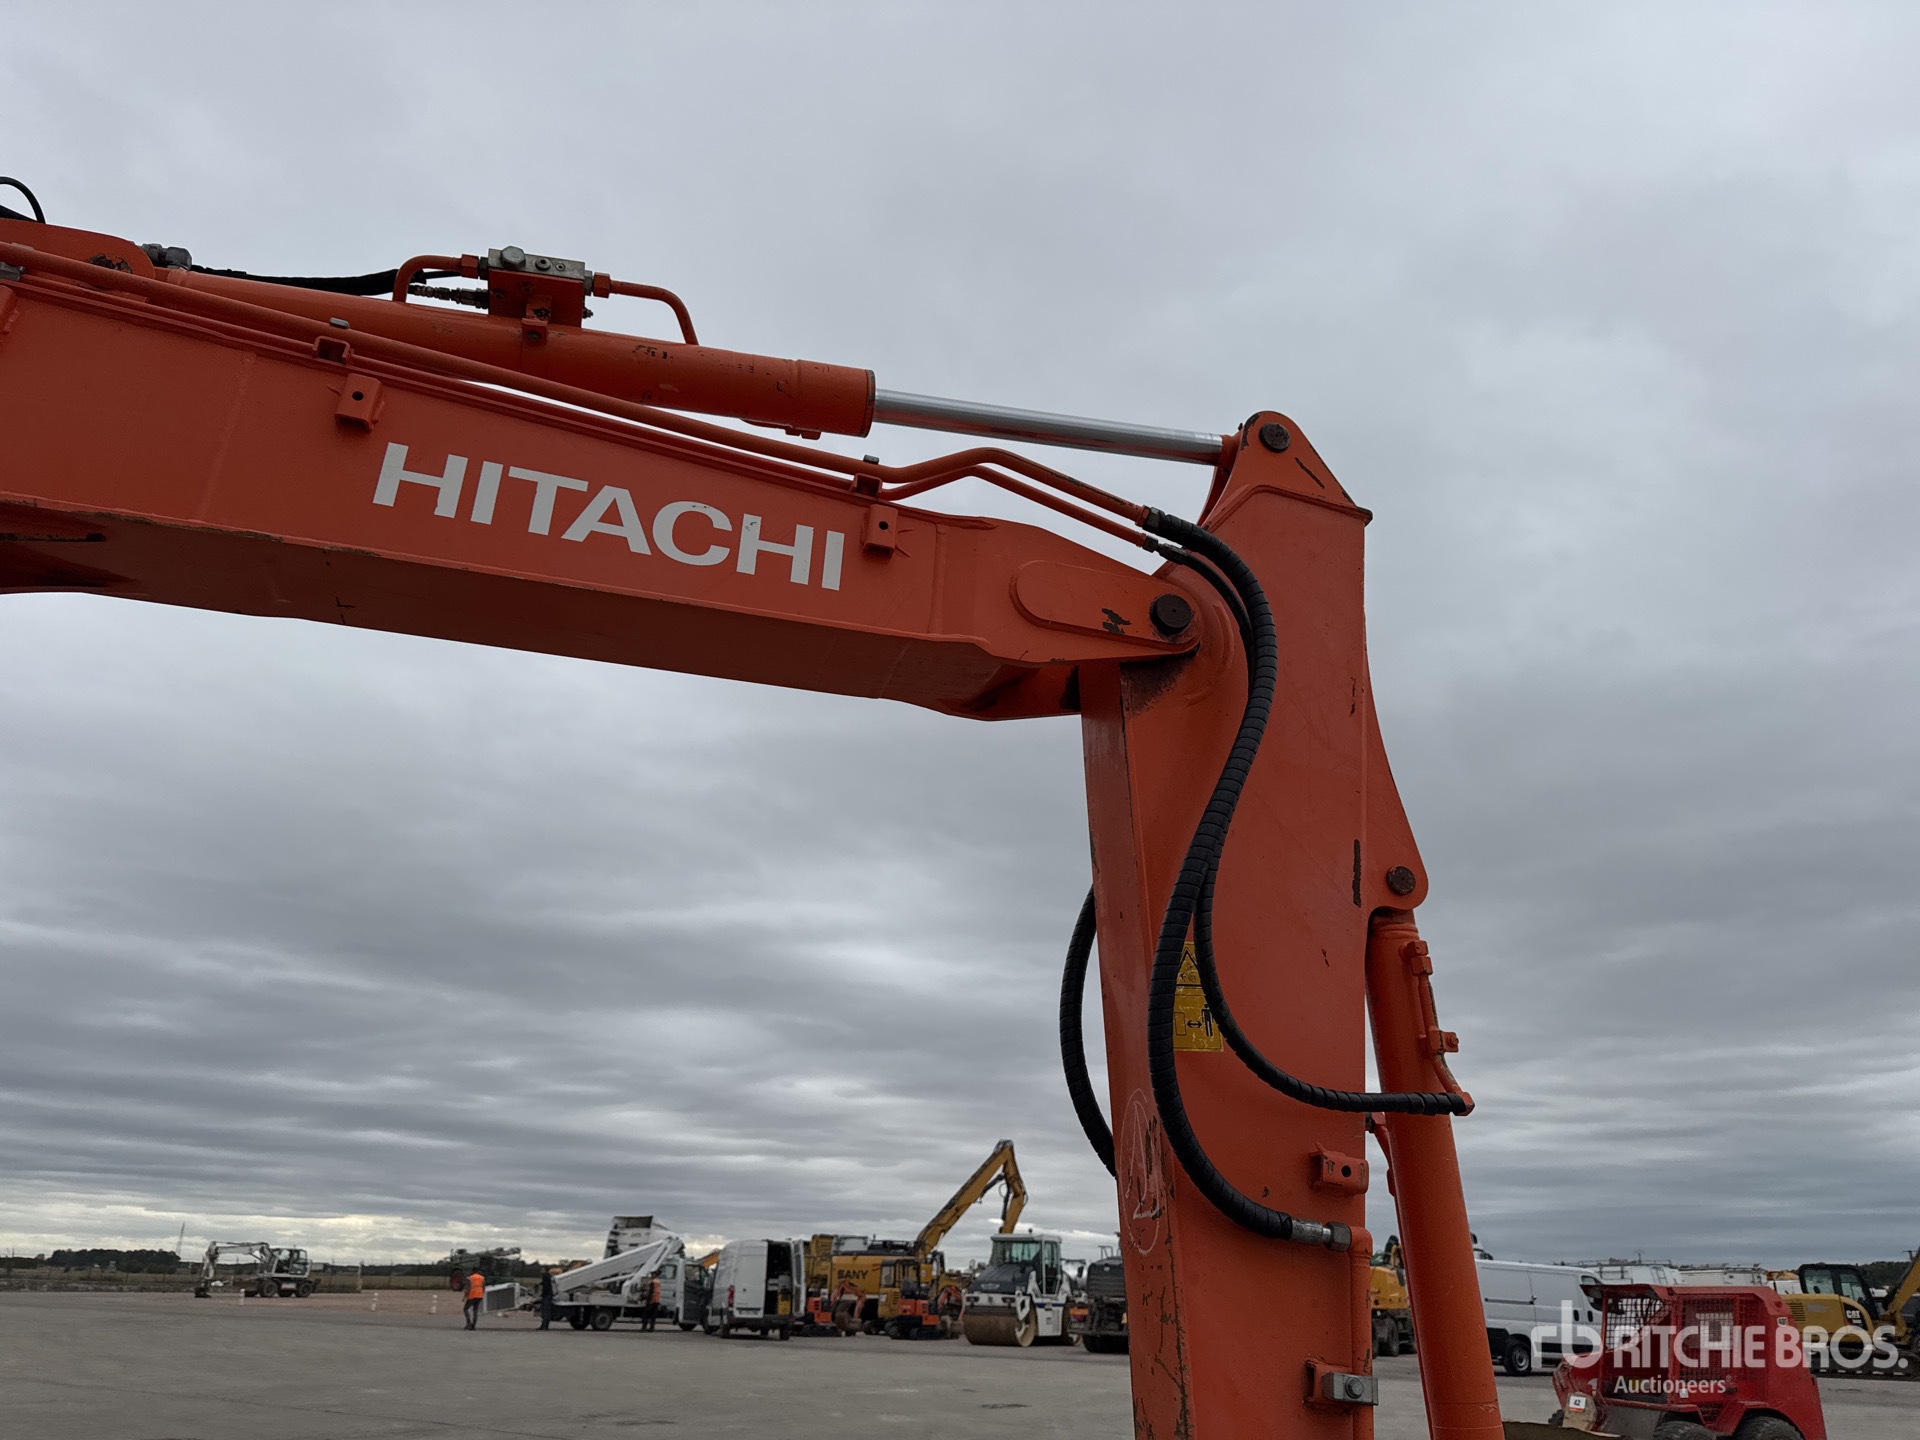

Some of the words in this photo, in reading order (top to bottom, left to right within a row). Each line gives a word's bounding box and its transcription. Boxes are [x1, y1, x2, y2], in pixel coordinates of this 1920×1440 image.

[372, 441, 845, 591] HITACHI
[837, 1269, 868, 1279] SANY
[1846, 1310, 1861, 1319] CAT
